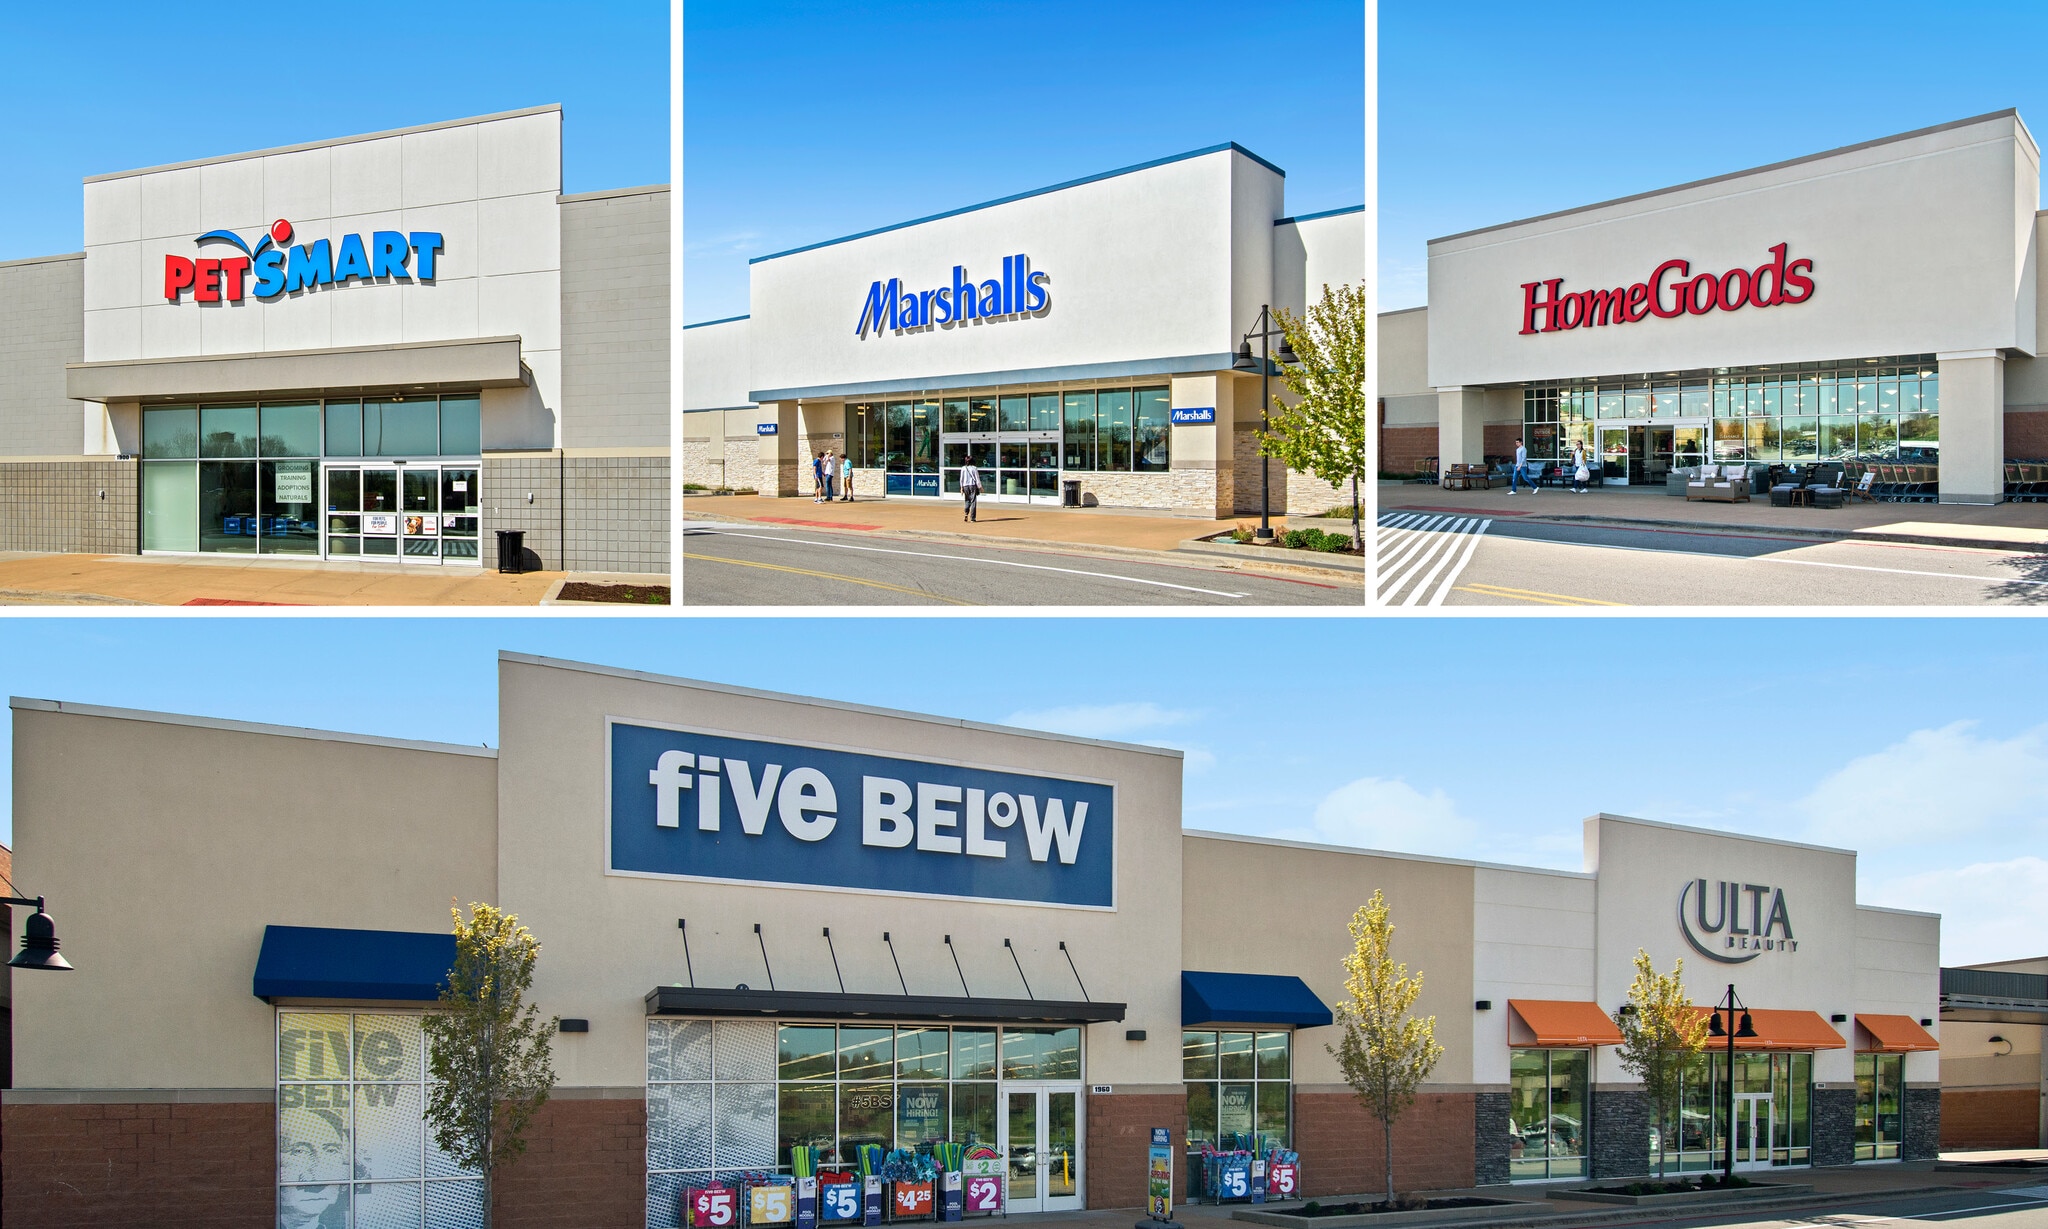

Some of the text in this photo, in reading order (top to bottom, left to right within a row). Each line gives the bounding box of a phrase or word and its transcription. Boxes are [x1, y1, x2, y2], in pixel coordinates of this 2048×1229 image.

[855, 253, 1049, 335] Marshalls
[1518, 242, 1815, 336] HomeGoods
[1172, 410, 1212, 421] Marshalls
[1697, 878, 1794, 939] ULTA
[1726, 936, 1799, 952] BEAUTY
[906, 1097, 938, 1109] NOW
[1222, 1095, 1246, 1106] NOW
[978, 1161, 990, 1174] $2
[1272, 1168, 1294, 1193] $5
[970, 1182, 997, 1210] $2
[1224, 1171, 1247, 1197] $5
[698, 1194, 732, 1225] $5
[754, 1191, 787, 1222] $5
[826, 1188, 858, 1218] $5
